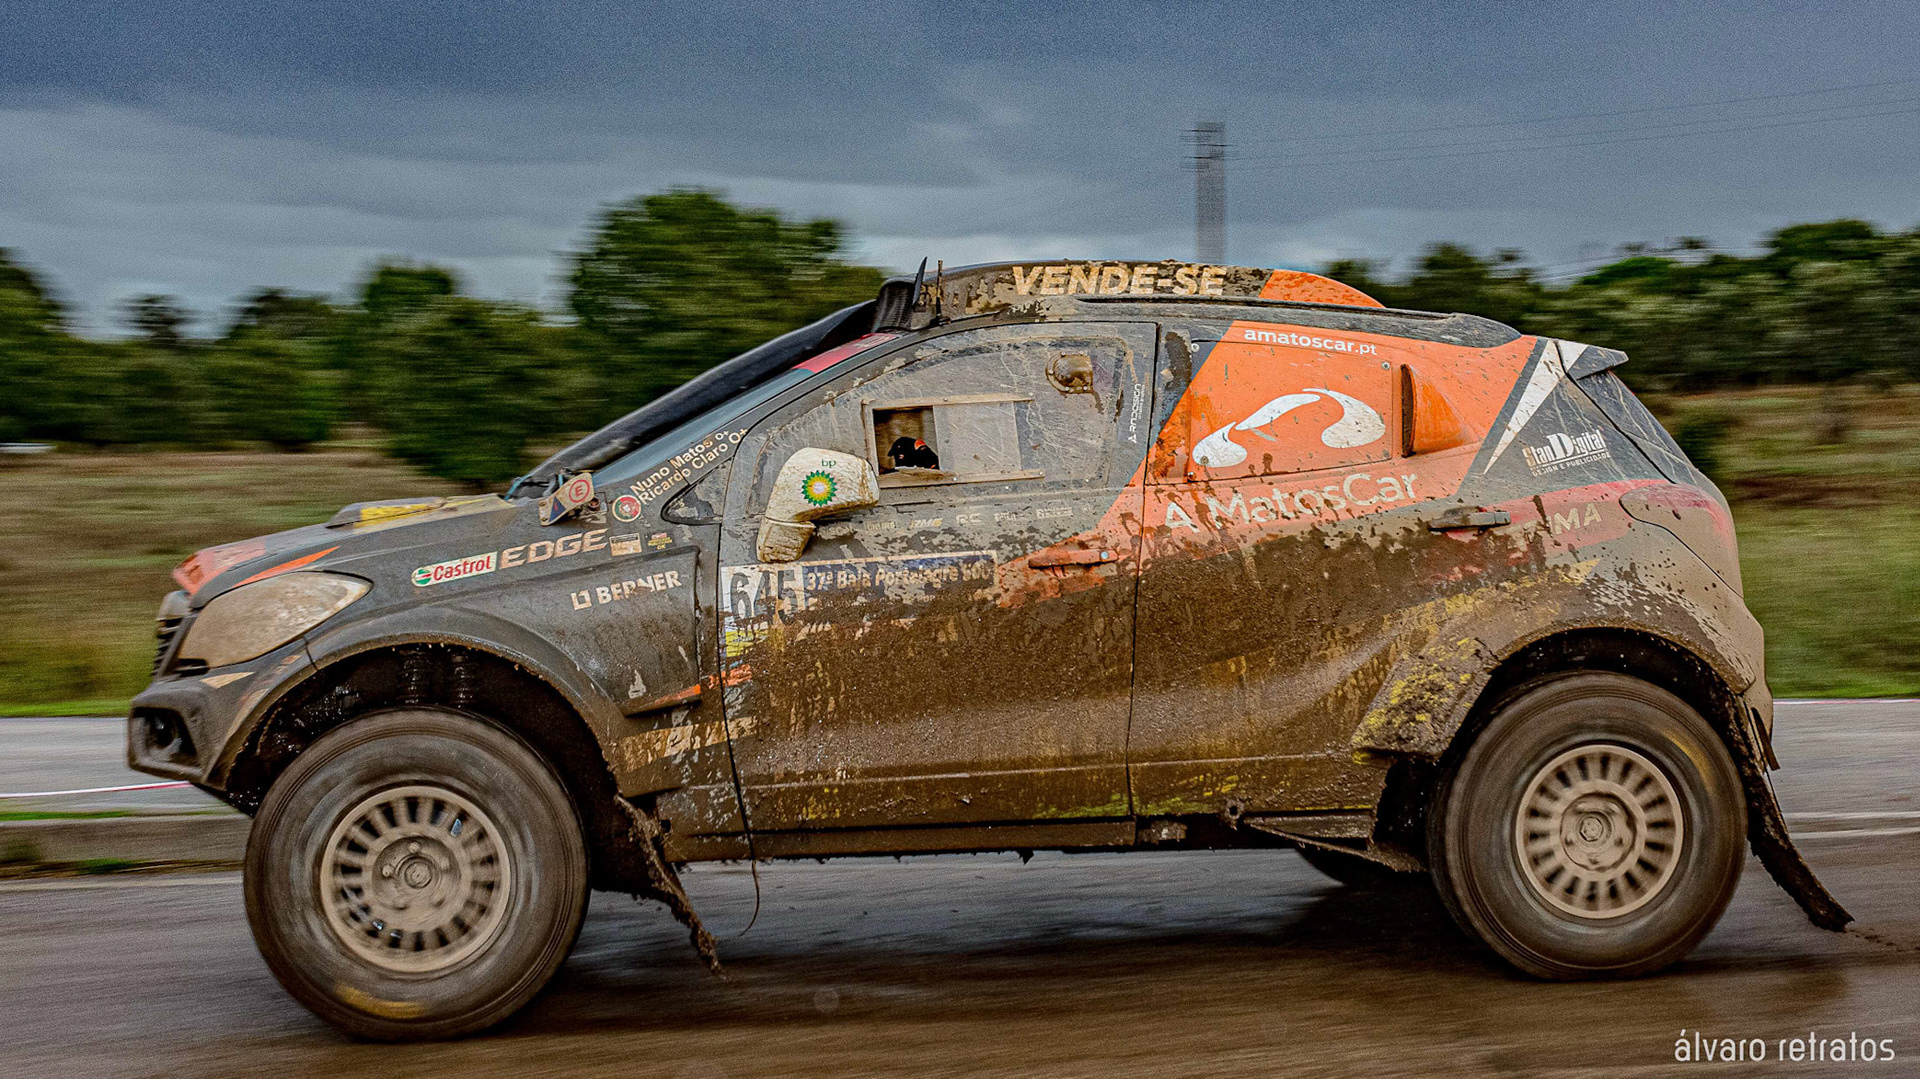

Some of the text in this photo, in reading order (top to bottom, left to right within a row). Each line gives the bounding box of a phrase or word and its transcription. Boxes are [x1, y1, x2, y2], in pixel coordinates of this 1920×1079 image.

[1012, 266, 1227, 296] VENDE-SE
[1243, 329, 1378, 355] amatoscar.pt
[630, 466, 670, 496] Nuno
[669, 438, 713, 469] Matos
[638, 468, 691, 505] Ricardo
[691, 442, 728, 469] Claro
[821, 459, 837, 468] bp
[1566, 451, 1611, 468] PUBLICIDADE
[574, 486, 584, 497] E
[1165, 472, 1418, 533] A MatosCar
[433, 555, 492, 582] Castrol
[499, 528, 609, 570] EDGE
[595, 570, 683, 605] BERNER
[836, 570, 872, 591] Baja
